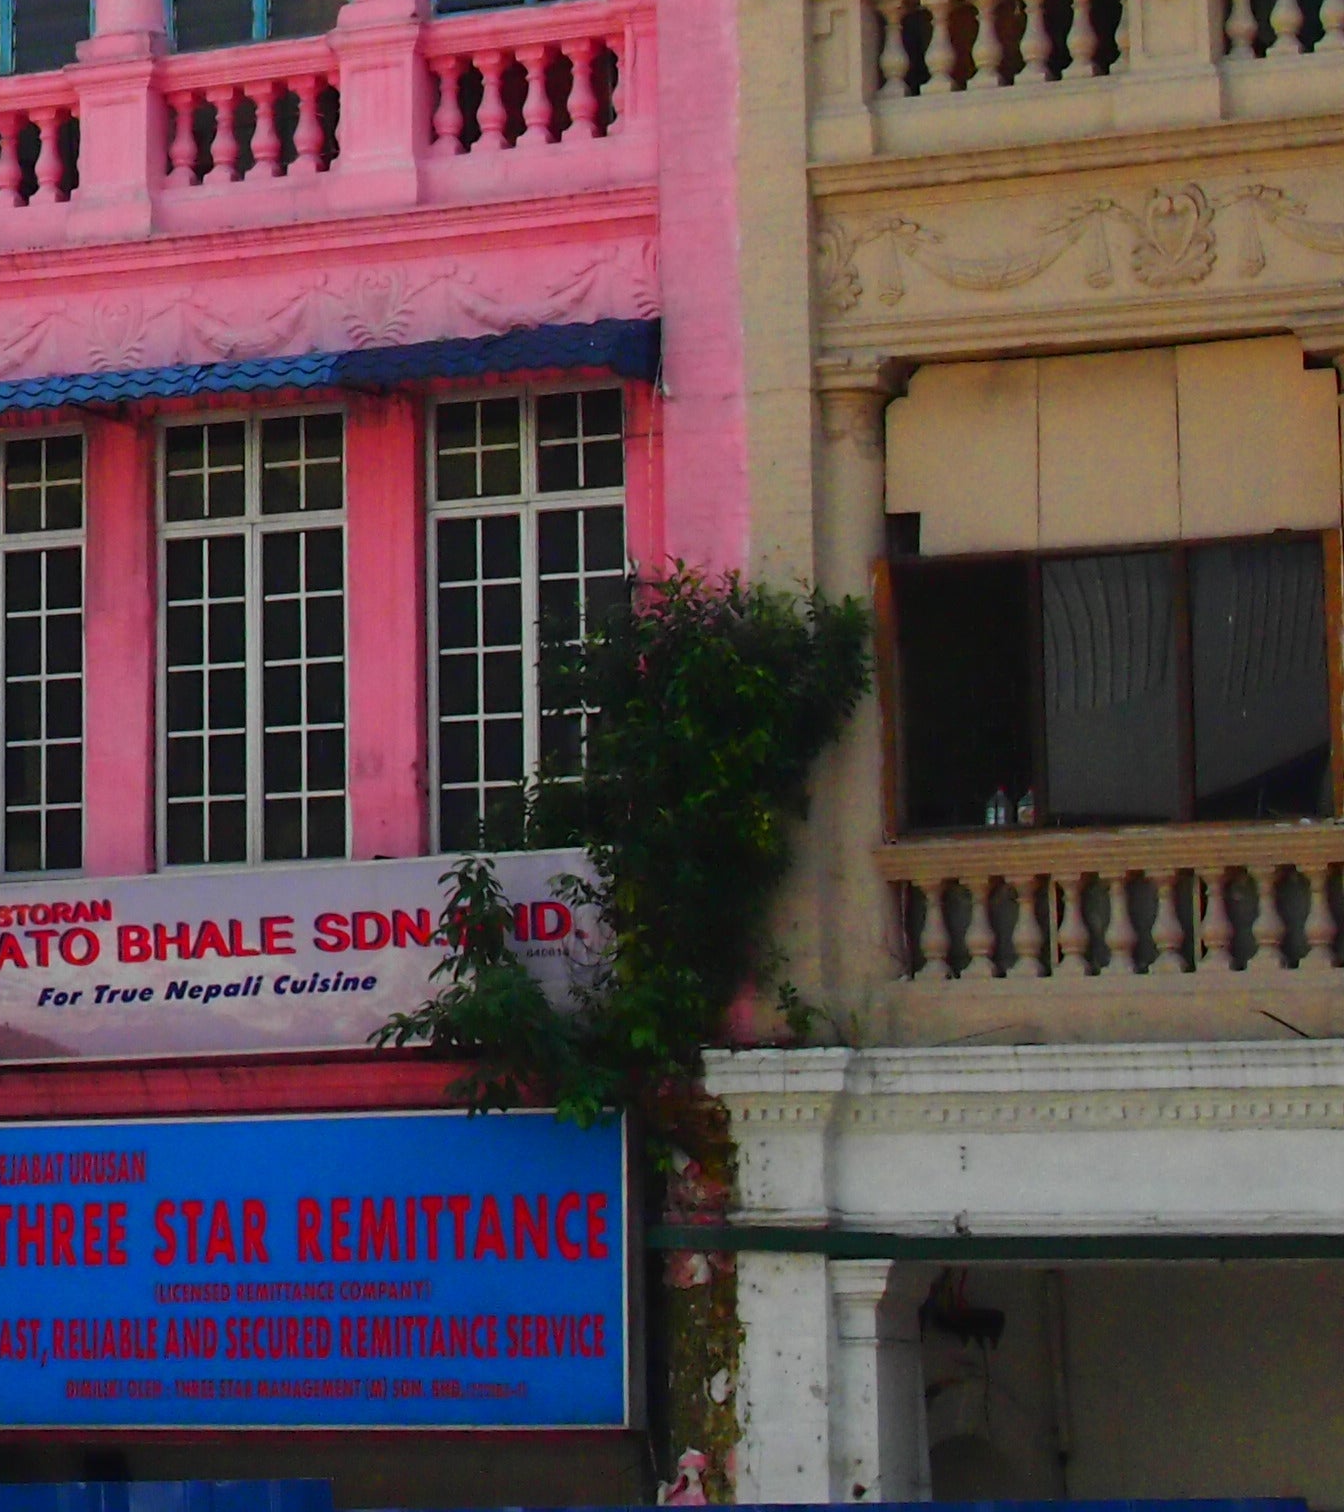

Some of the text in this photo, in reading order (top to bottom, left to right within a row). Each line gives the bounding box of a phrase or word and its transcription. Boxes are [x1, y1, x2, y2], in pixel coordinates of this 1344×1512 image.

[117, 915, 296, 963] BHALE
[37, 972, 378, 1008] For True Nepali Cuisine
[69, 1150, 147, 1185] URUSAN
[153, 1198, 269, 1267] STAR
[297, 1191, 609, 1263] REMITTANCE
[237, 1281, 335, 1303] REMITTANCE
[52, 1317, 158, 1360] RELIABLE
[164, 1316, 218, 1360] AND
[225, 1315, 332, 1360] SECURED
[339, 1314, 498, 1359] REMITTANCE
[506, 1313, 606, 1359] SERVICE
[175, 1379, 215, 1400] THREE
